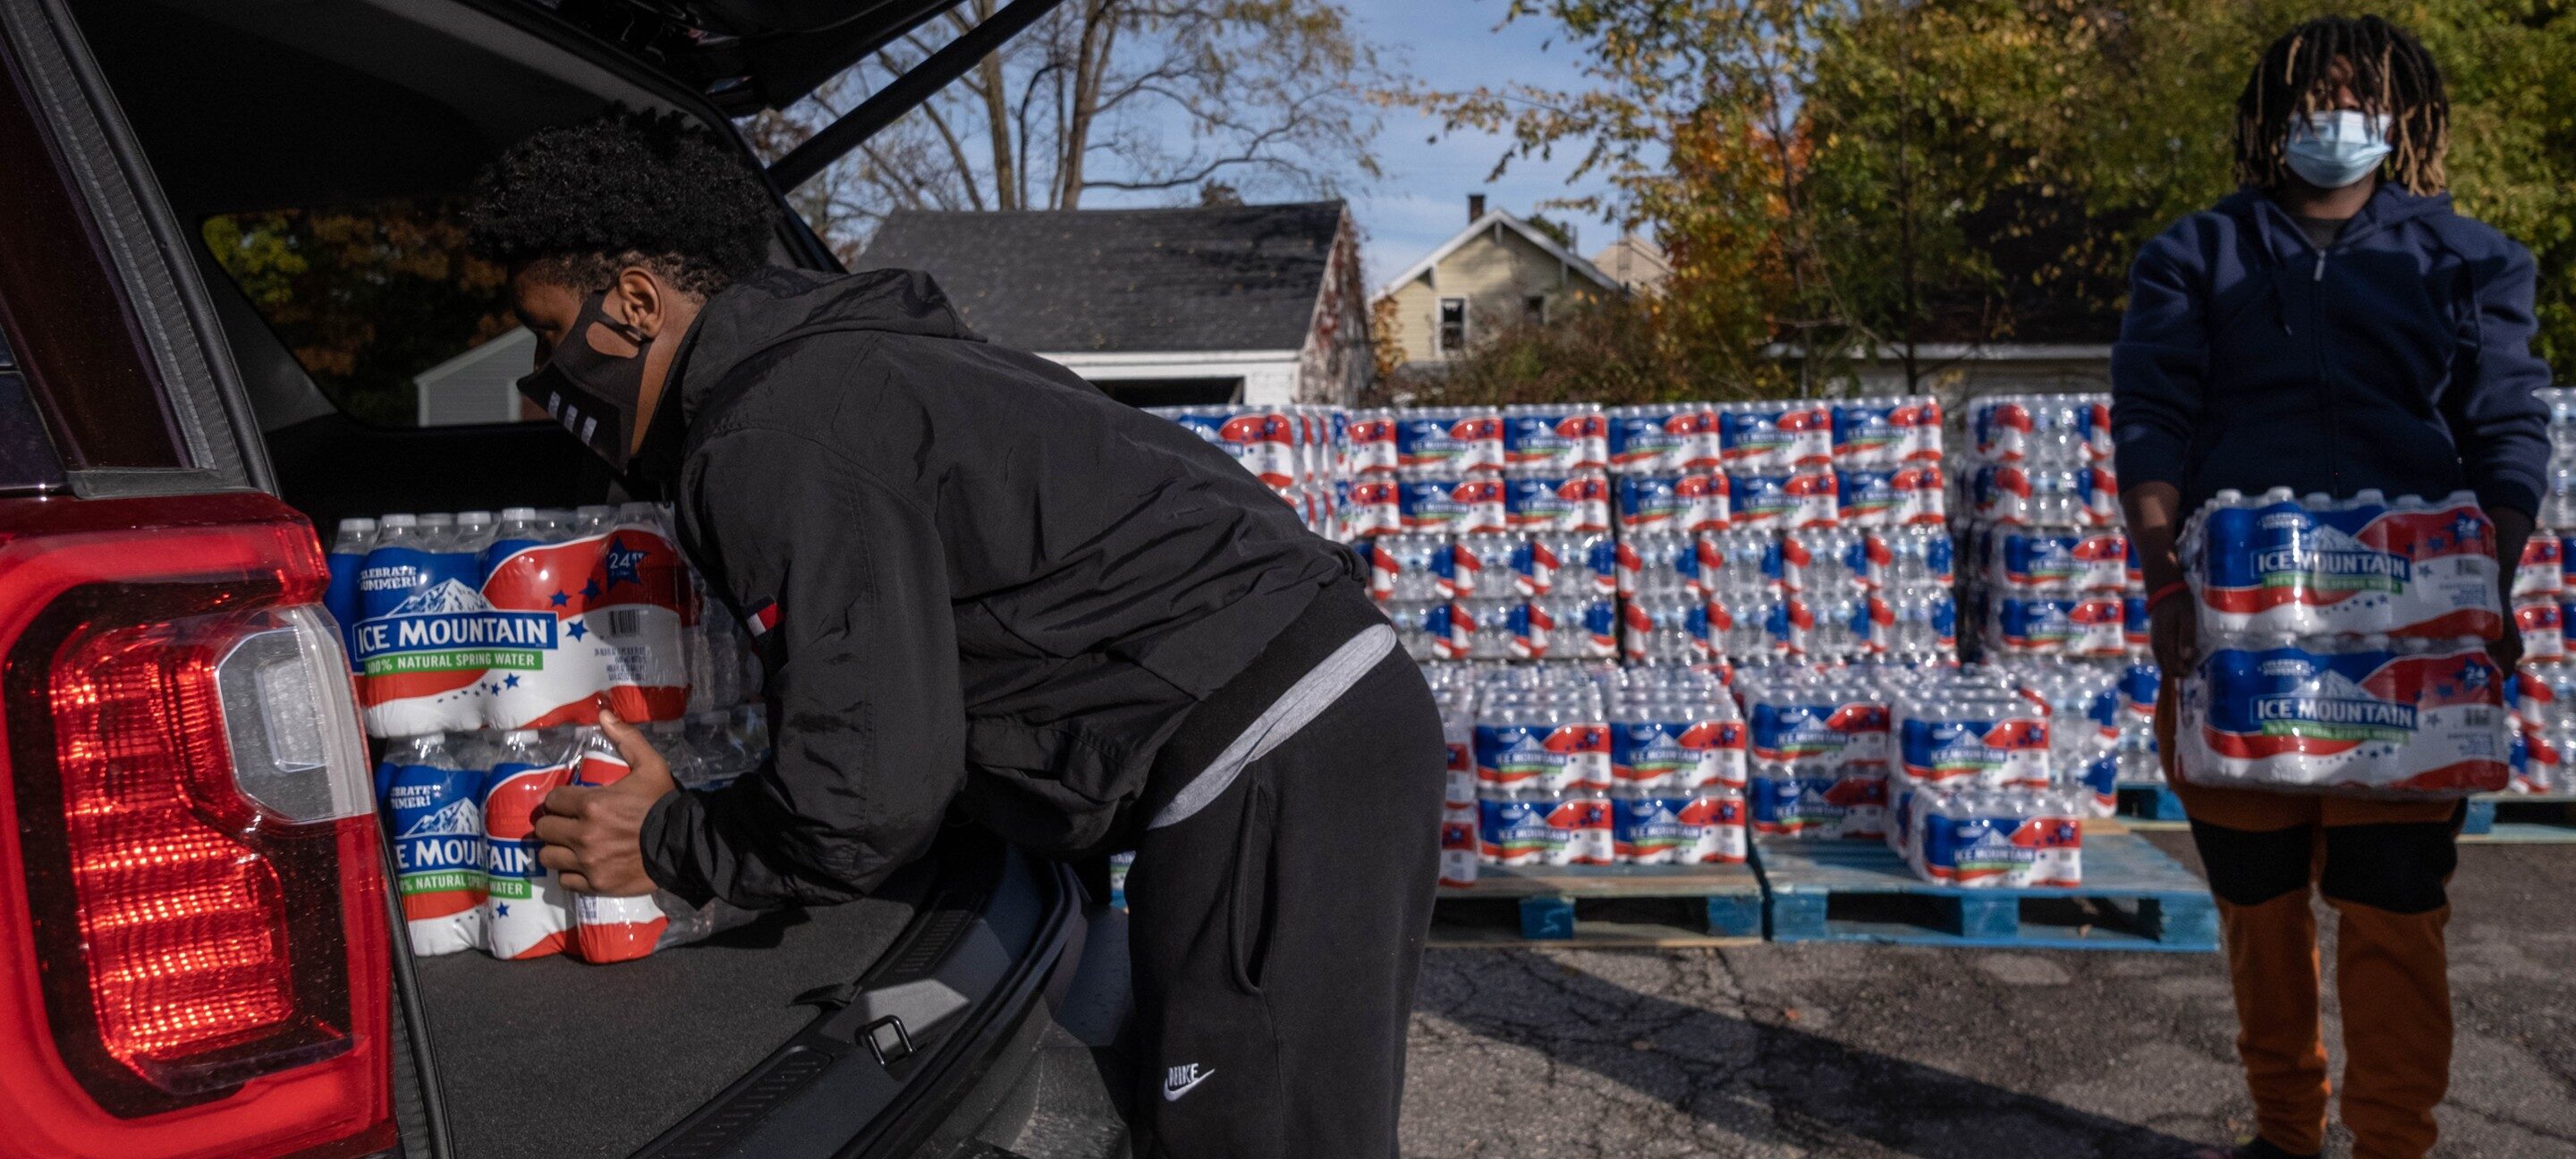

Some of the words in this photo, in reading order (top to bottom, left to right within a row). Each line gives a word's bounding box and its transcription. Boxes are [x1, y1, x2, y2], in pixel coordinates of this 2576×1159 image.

[609, 553, 630, 569] 24
[2258, 551, 2292, 572] ICE
[2298, 551, 2405, 579] MOUNTAIN
[360, 565, 417, 580] ELEBRATE
[360, 576, 417, 590] UMMER!
[359, 624, 390, 654] ICE
[399, 619, 547, 647] MOUNTAIN
[367, 657, 393, 673] 100%
[397, 654, 452, 669] NATURAL
[455, 652, 491, 666] SPRING
[496, 652, 535, 666] WATER
[2258, 699, 2292, 719] ICE
[2299, 698, 2412, 727] MOUNTAIN
[416, 875, 466, 890] NATURAL
[489, 881, 523, 894] WATER
[1167, 1062, 1199, 1087] NIKE
